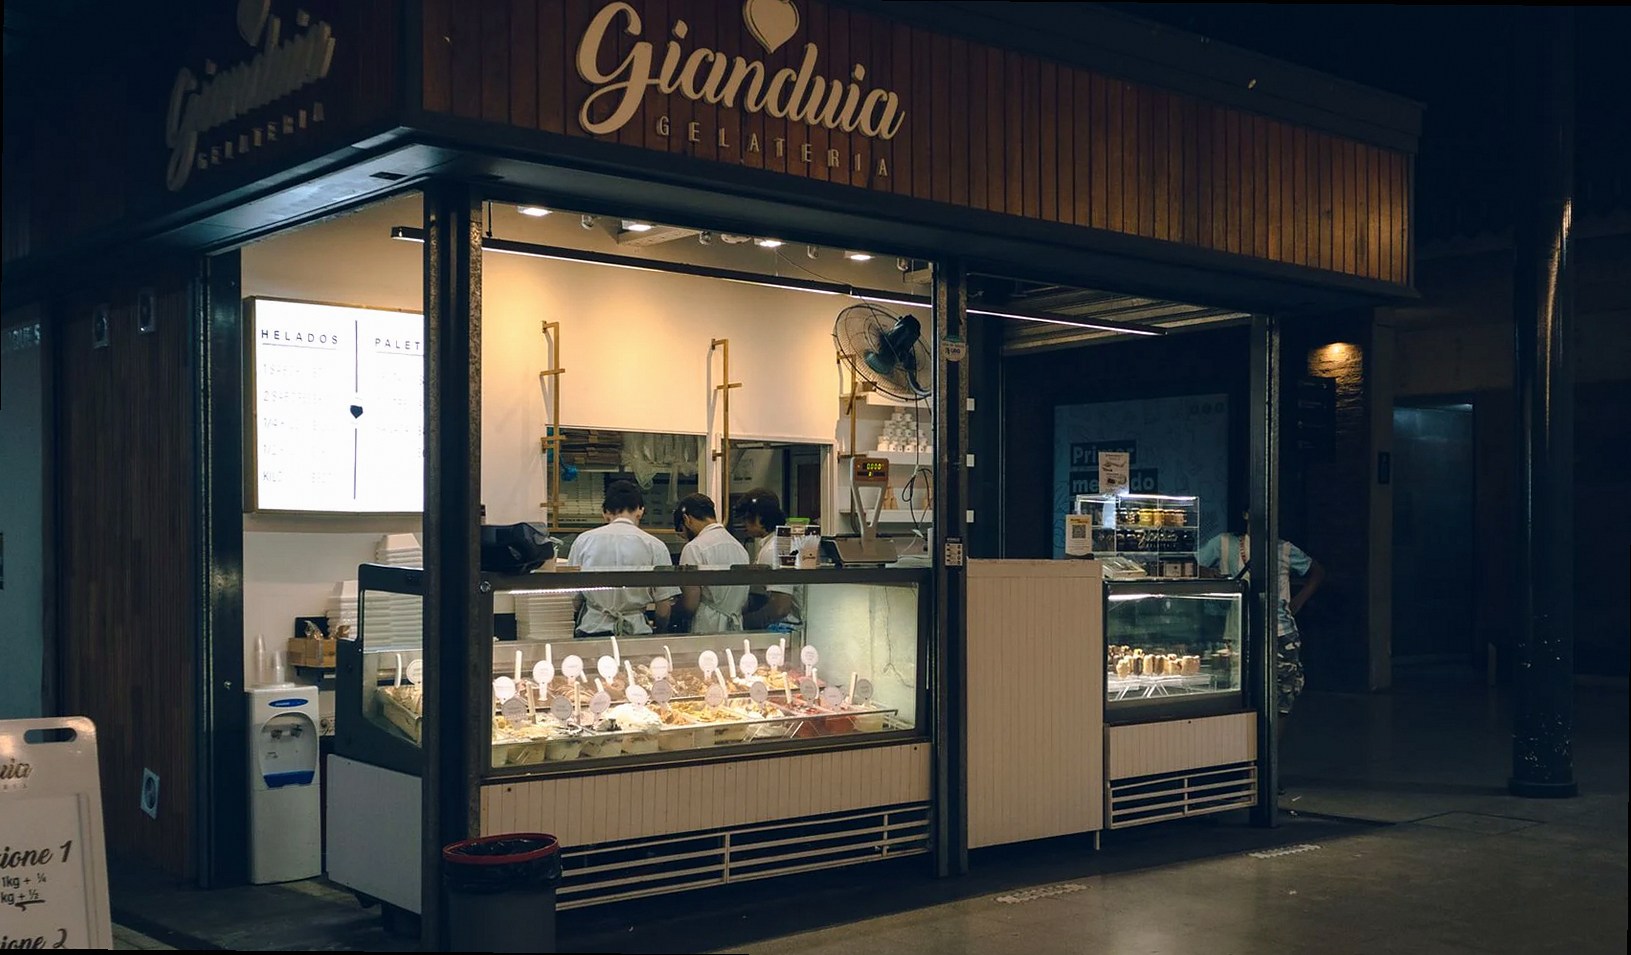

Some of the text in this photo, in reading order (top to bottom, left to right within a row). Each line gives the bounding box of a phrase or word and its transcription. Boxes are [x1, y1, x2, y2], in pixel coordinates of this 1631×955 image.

[576, 1, 906, 140] Gianduia
[656, 115, 889, 178] GELATERIA
[261, 329, 339, 345] HELADOS
[374, 337, 421, 351] PALET
[60, 840, 73, 863] 1
[2, 875, 20, 889] 1kg
[53, 928, 67, 949] 2
